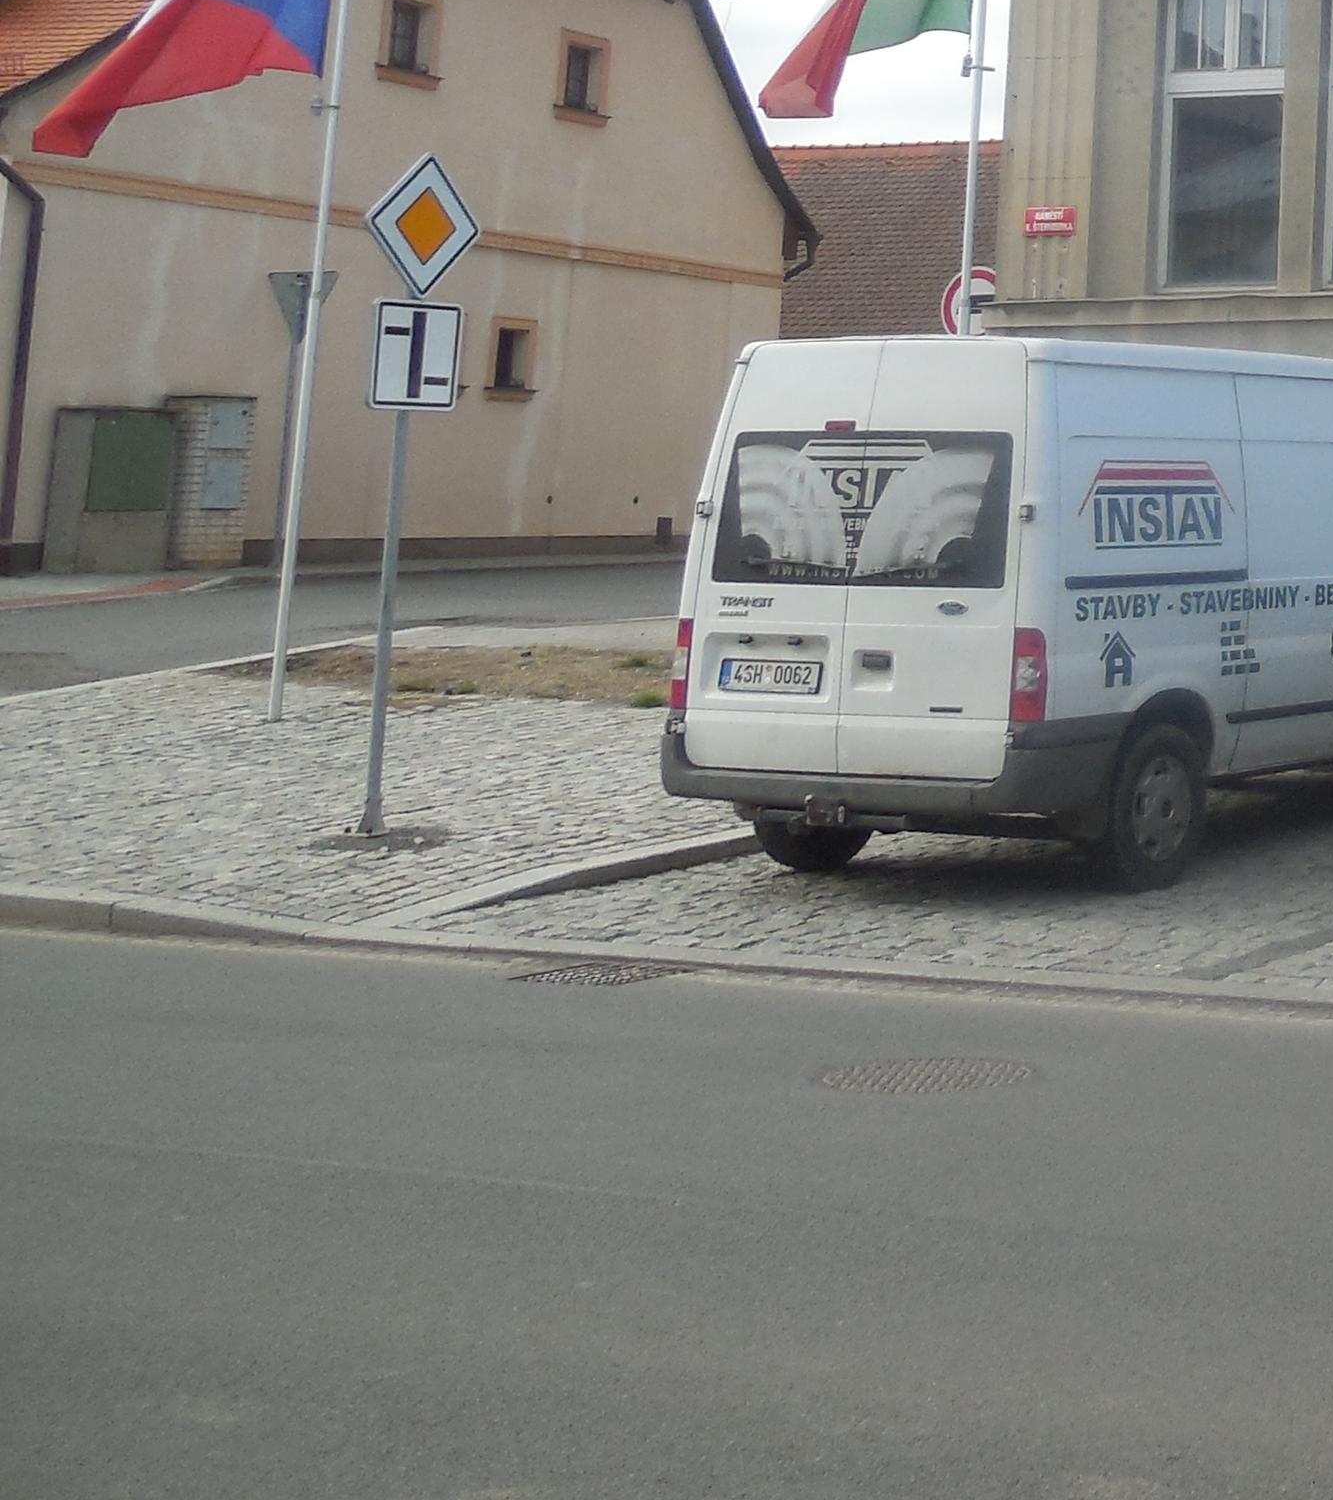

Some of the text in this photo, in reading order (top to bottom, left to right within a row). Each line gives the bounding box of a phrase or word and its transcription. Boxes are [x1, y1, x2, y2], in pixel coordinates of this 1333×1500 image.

[1094, 493, 1222, 543] INSTAV
[1075, 593, 1161, 622] STAVBY
[1180, 585, 1301, 615] STAVEBNINY
[734, 663, 812, 686] 4SH 0062
